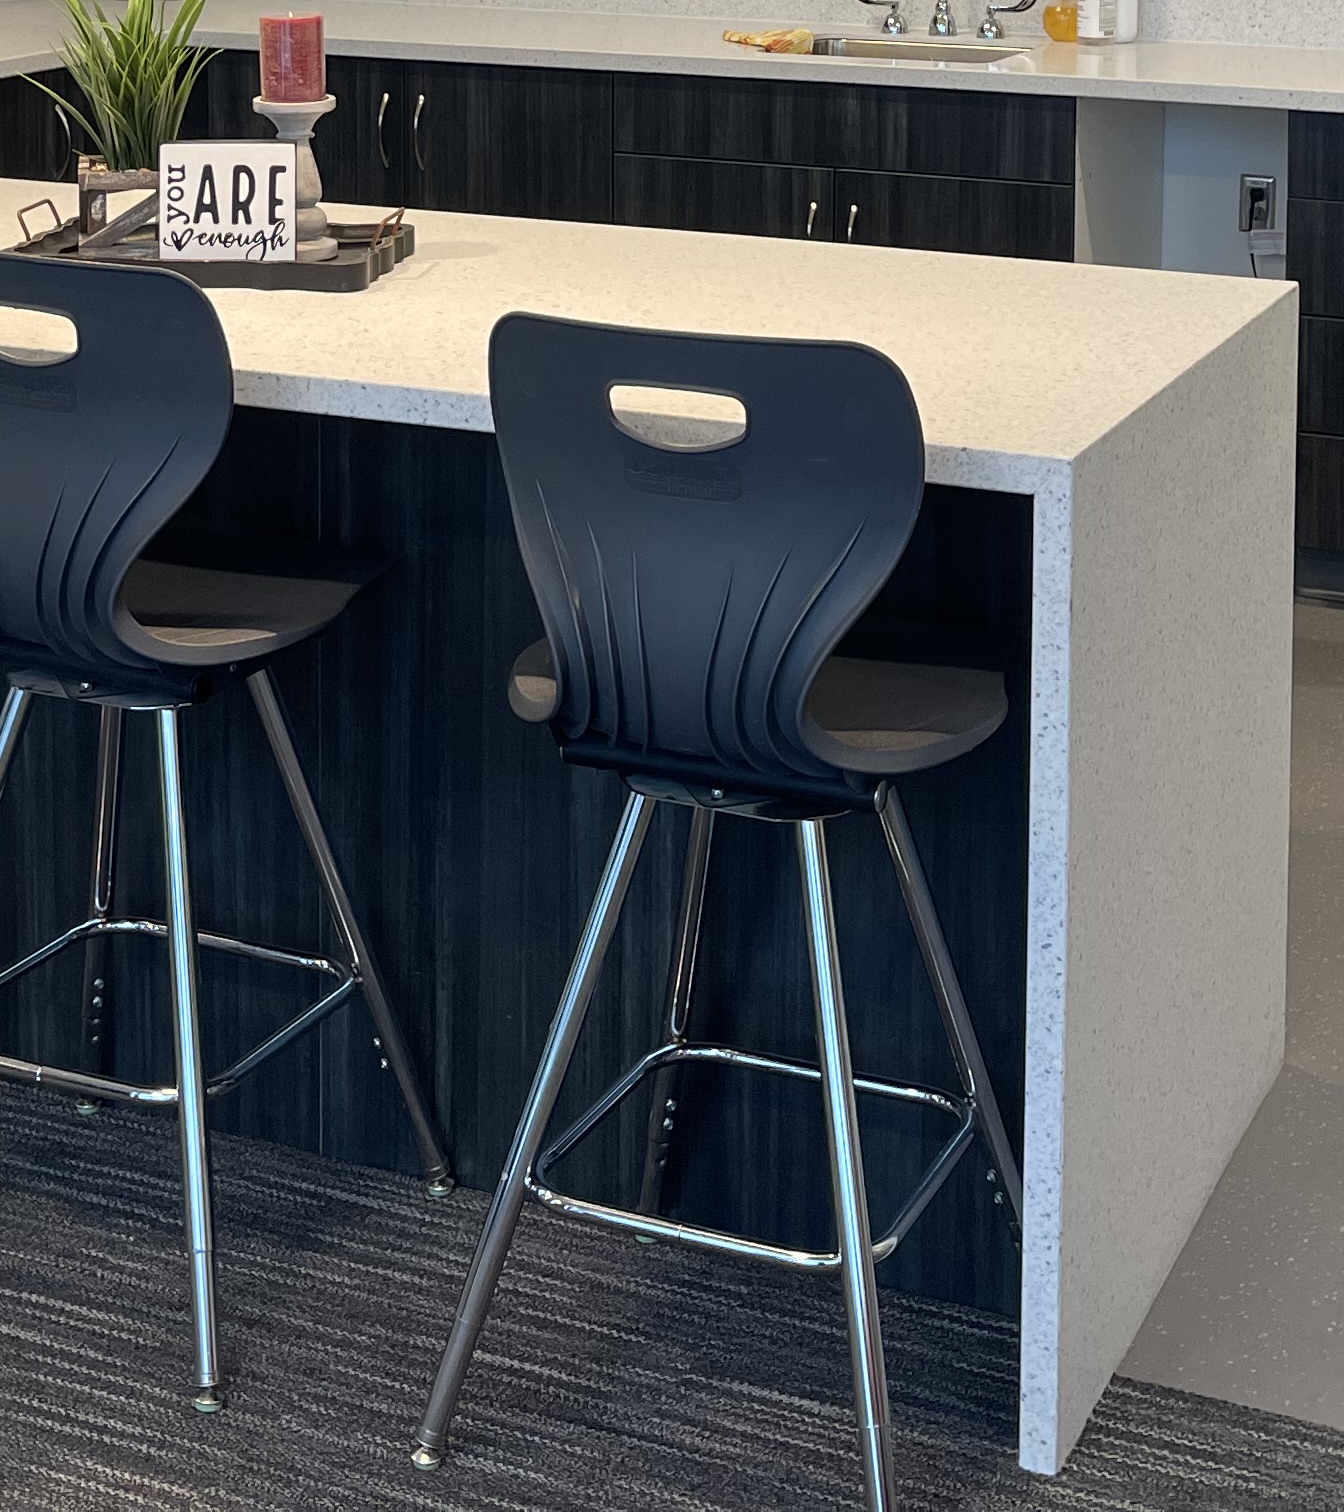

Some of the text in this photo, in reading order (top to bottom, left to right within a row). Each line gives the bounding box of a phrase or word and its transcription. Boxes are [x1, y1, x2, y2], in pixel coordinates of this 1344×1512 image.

[167, 164, 190, 225] you
[192, 164, 287, 225] ARE
[193, 219, 289, 261] enough
